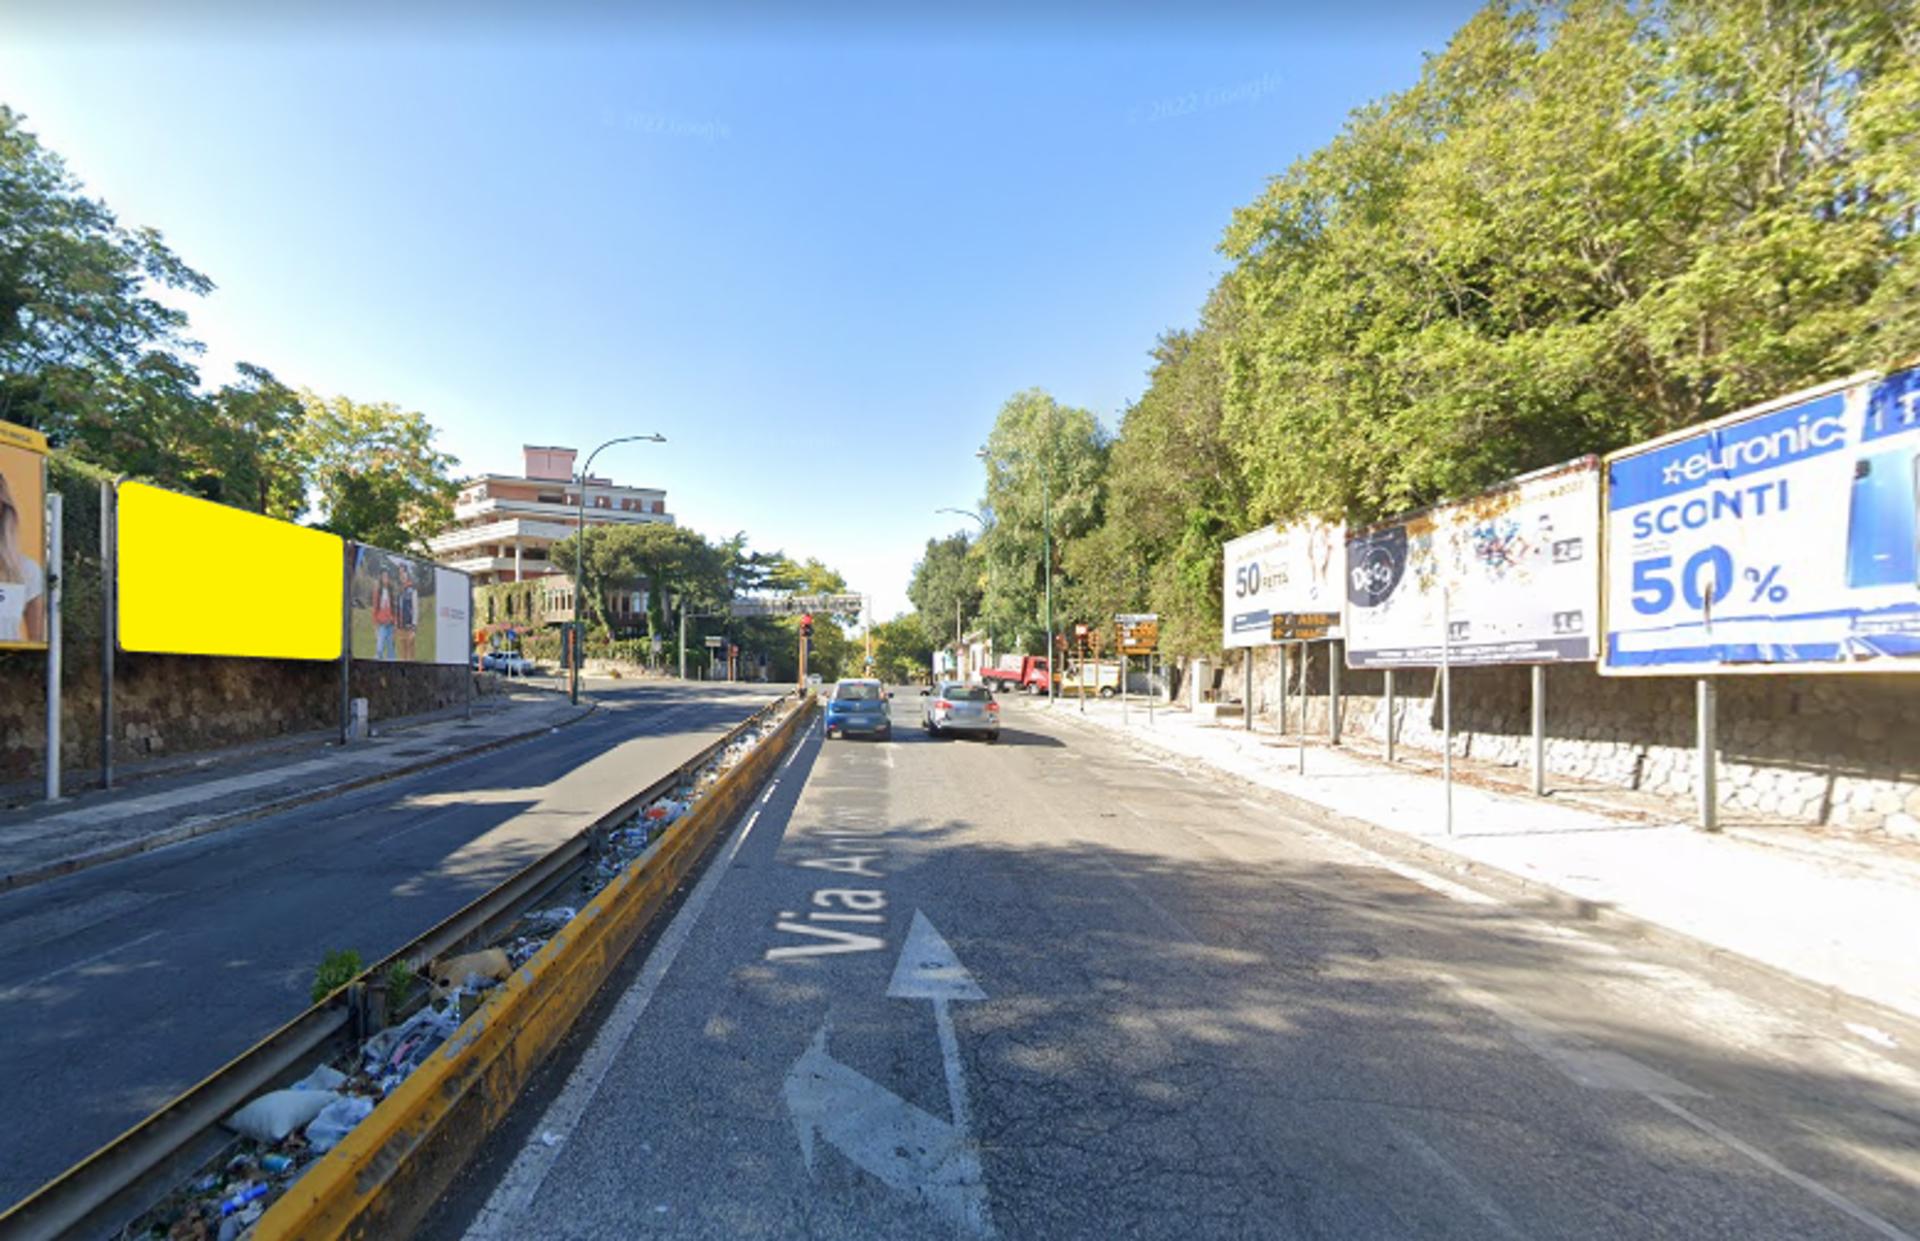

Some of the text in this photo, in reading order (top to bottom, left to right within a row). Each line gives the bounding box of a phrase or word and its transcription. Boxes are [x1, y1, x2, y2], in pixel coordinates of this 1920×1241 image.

[1686, 416, 1848, 475] euronic
[1633, 480, 1788, 539] SCONTI
[1236, 563, 1260, 598] 50
[767, 889, 887, 960] Via
